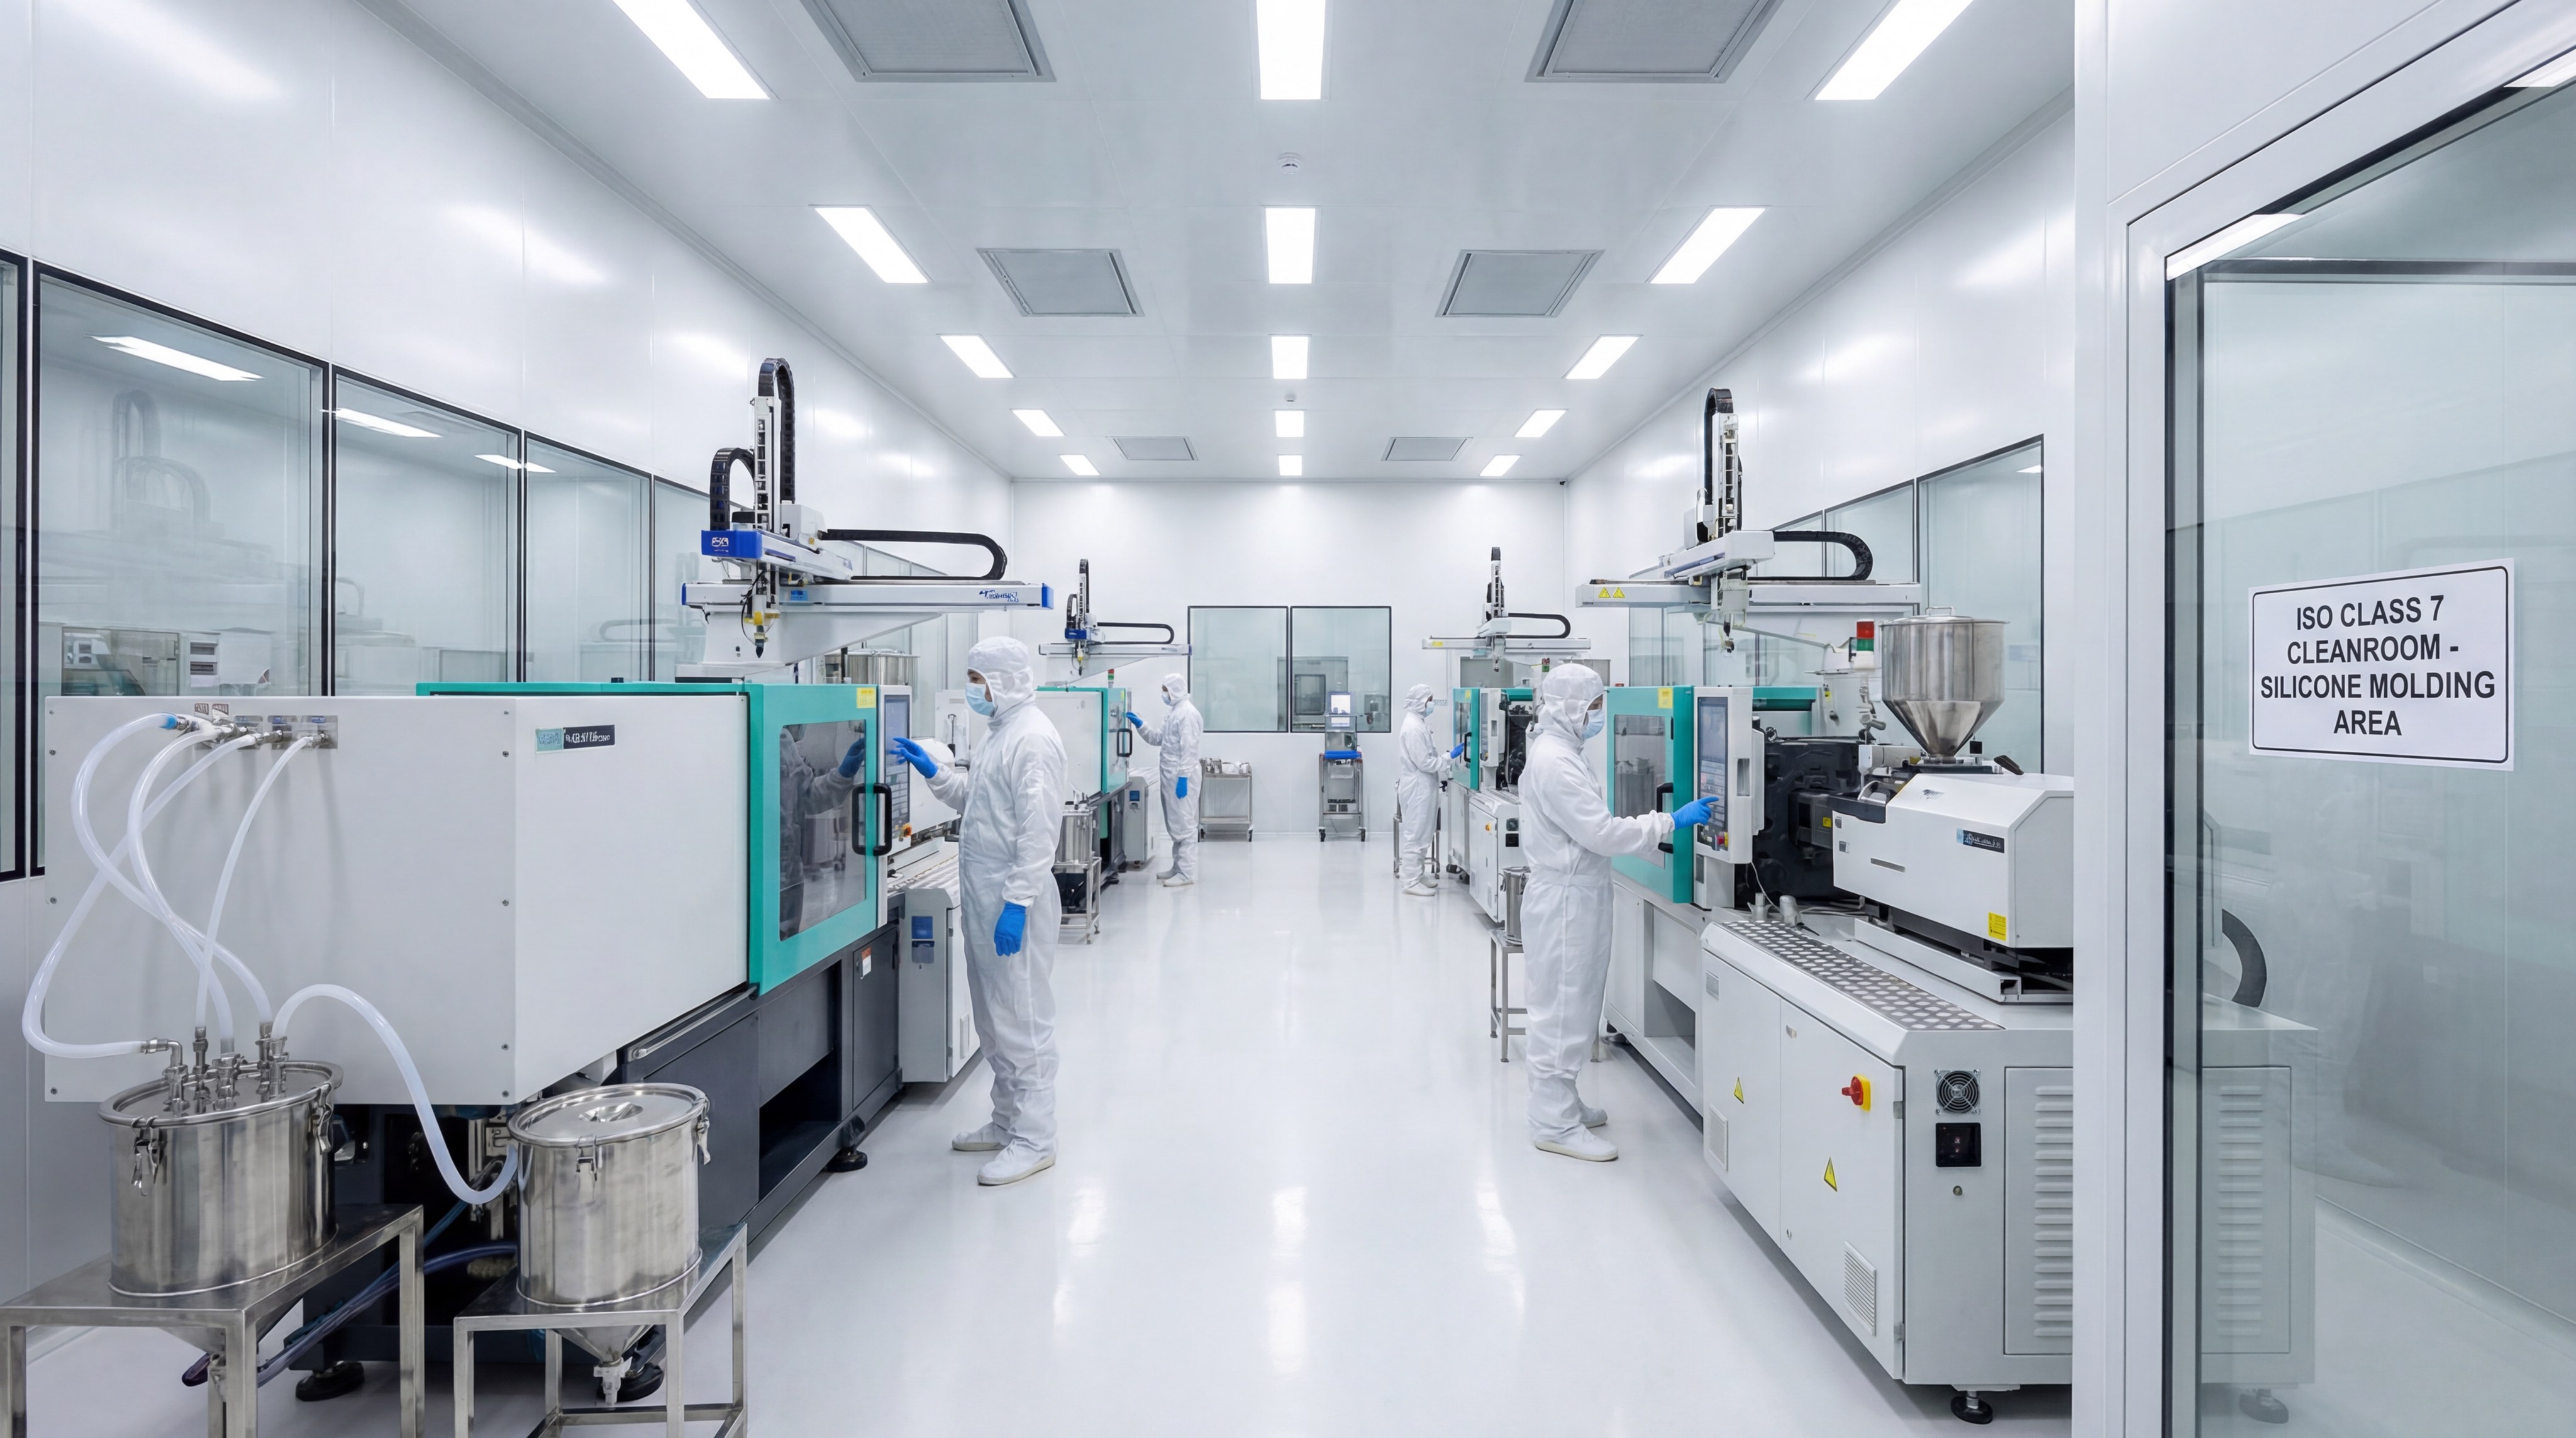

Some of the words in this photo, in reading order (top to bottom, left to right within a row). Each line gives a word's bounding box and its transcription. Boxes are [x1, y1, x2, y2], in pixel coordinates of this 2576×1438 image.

[2297, 605, 2333, 630] ISO
[2340, 596, 2422, 627] CLASS
[2430, 594, 2444, 621] 7
[2287, 633, 2440, 665] CLEANROOM
[2260, 674, 2362, 699] SILICONE
[2370, 671, 2495, 699] MOLDING
[2333, 710, 2402, 736] AREA
